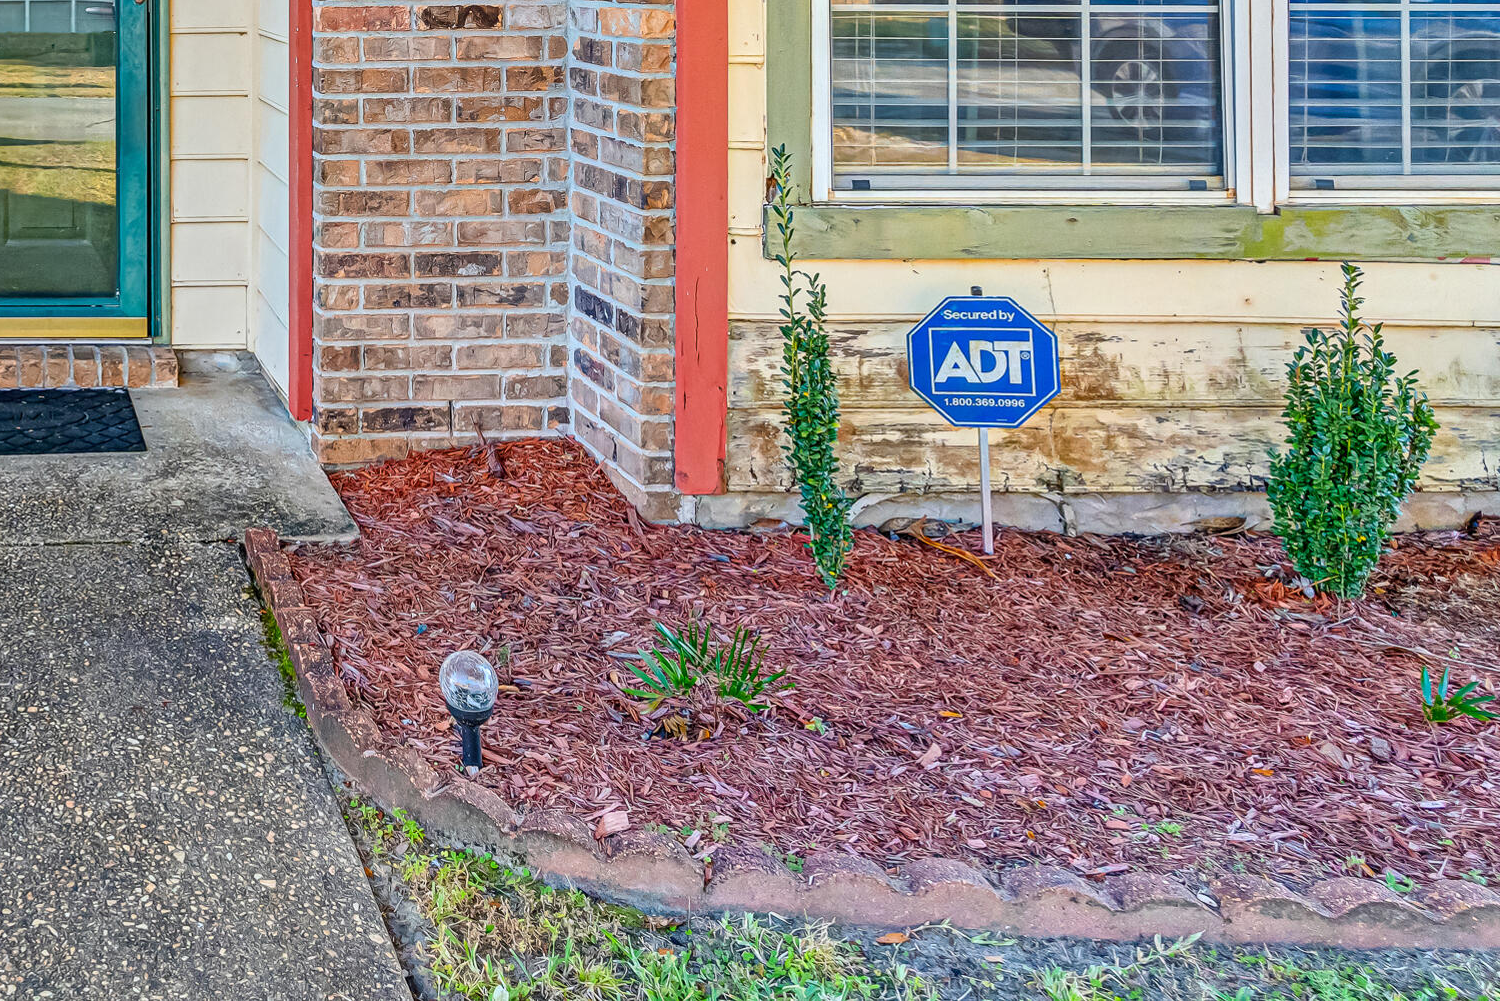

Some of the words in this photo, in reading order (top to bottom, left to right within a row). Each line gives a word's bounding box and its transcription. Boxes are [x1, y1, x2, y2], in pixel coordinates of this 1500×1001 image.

[943, 309, 997, 320] Secured
[999, 309, 1015, 322] by
[934, 340, 1031, 385] ADT
[944, 398, 1026, 408] 1.800.369.0996
